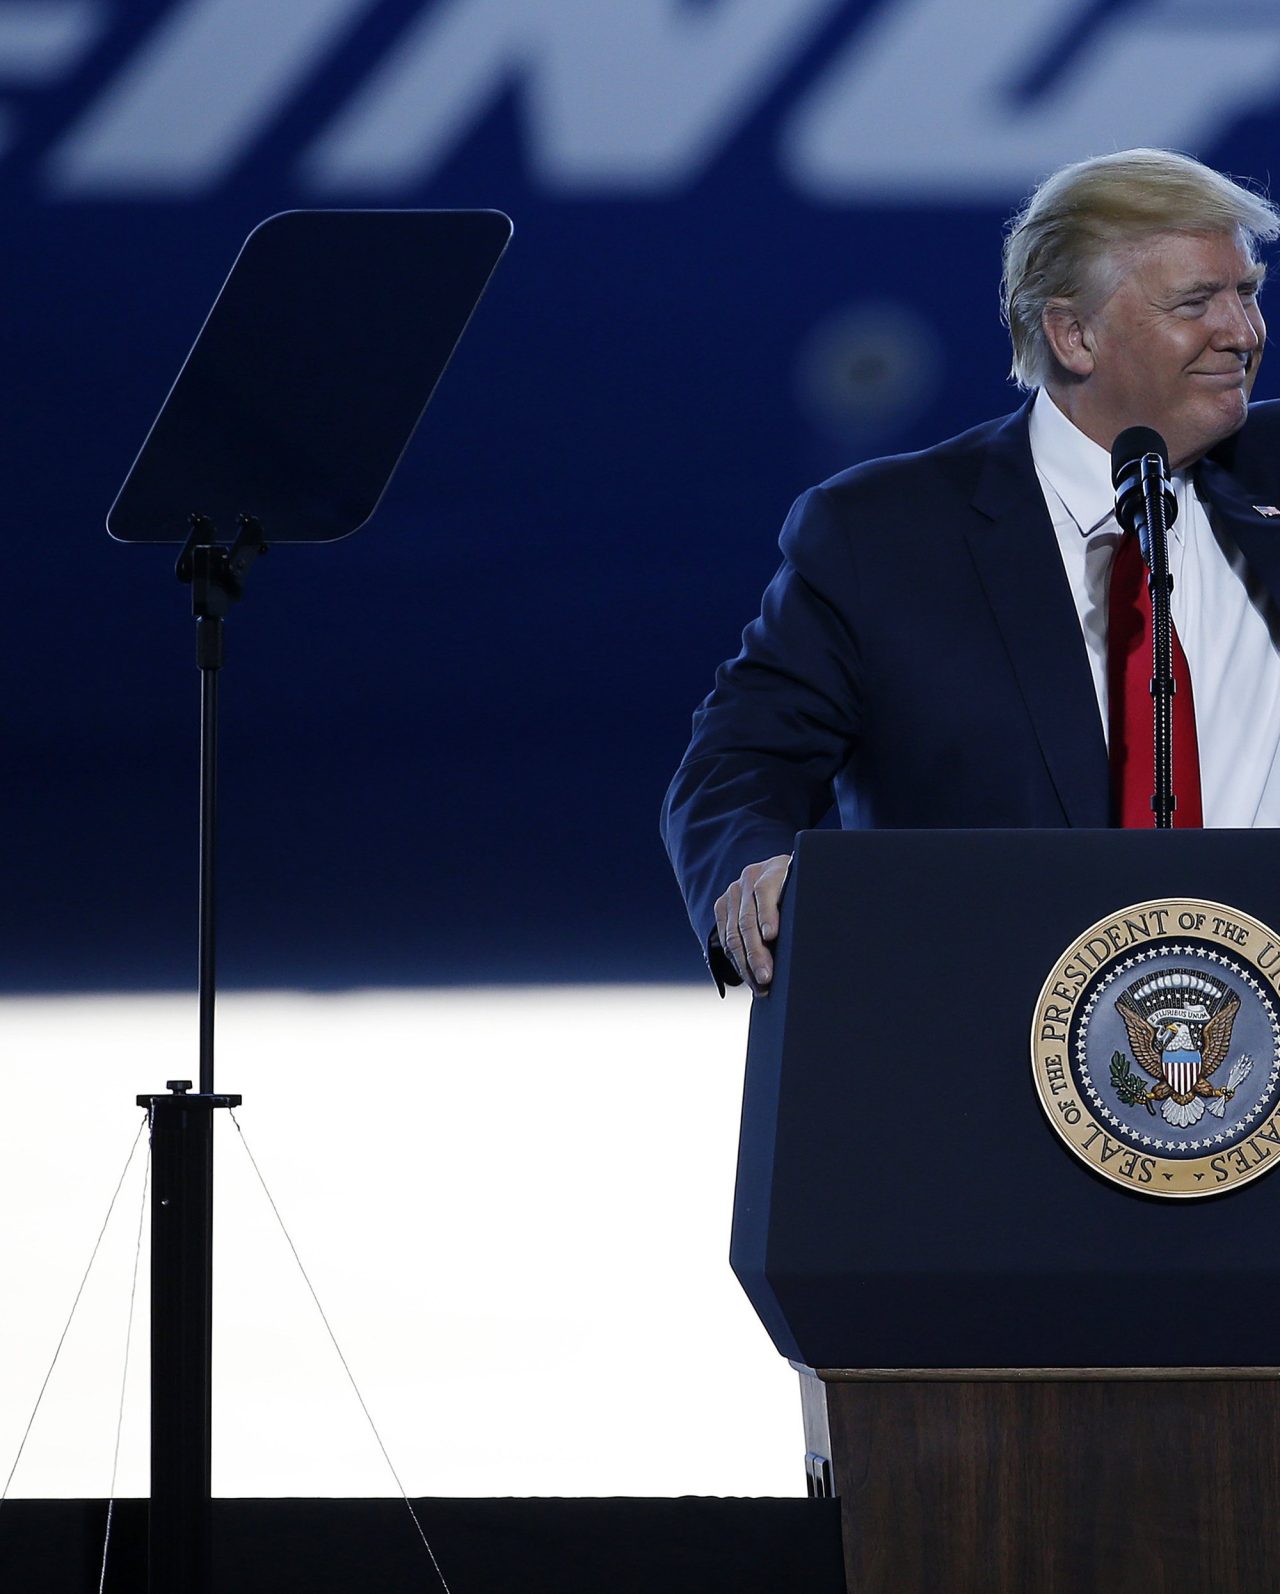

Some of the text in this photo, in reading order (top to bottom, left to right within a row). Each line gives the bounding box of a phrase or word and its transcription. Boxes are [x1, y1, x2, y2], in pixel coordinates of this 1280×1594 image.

[1178, 912, 1206, 930] OF
[1212, 917, 1250, 946] THE
[1041, 909, 1169, 1043] PRESIDENT
[1155, 1009, 1187, 1018] PLURIBUS
[1187, 1011, 1208, 1020] UNUM
[1045, 1054, 1068, 1095] THE
[1058, 1100, 1082, 1124] OF
[1081, 1122, 1156, 1183] SEAL
